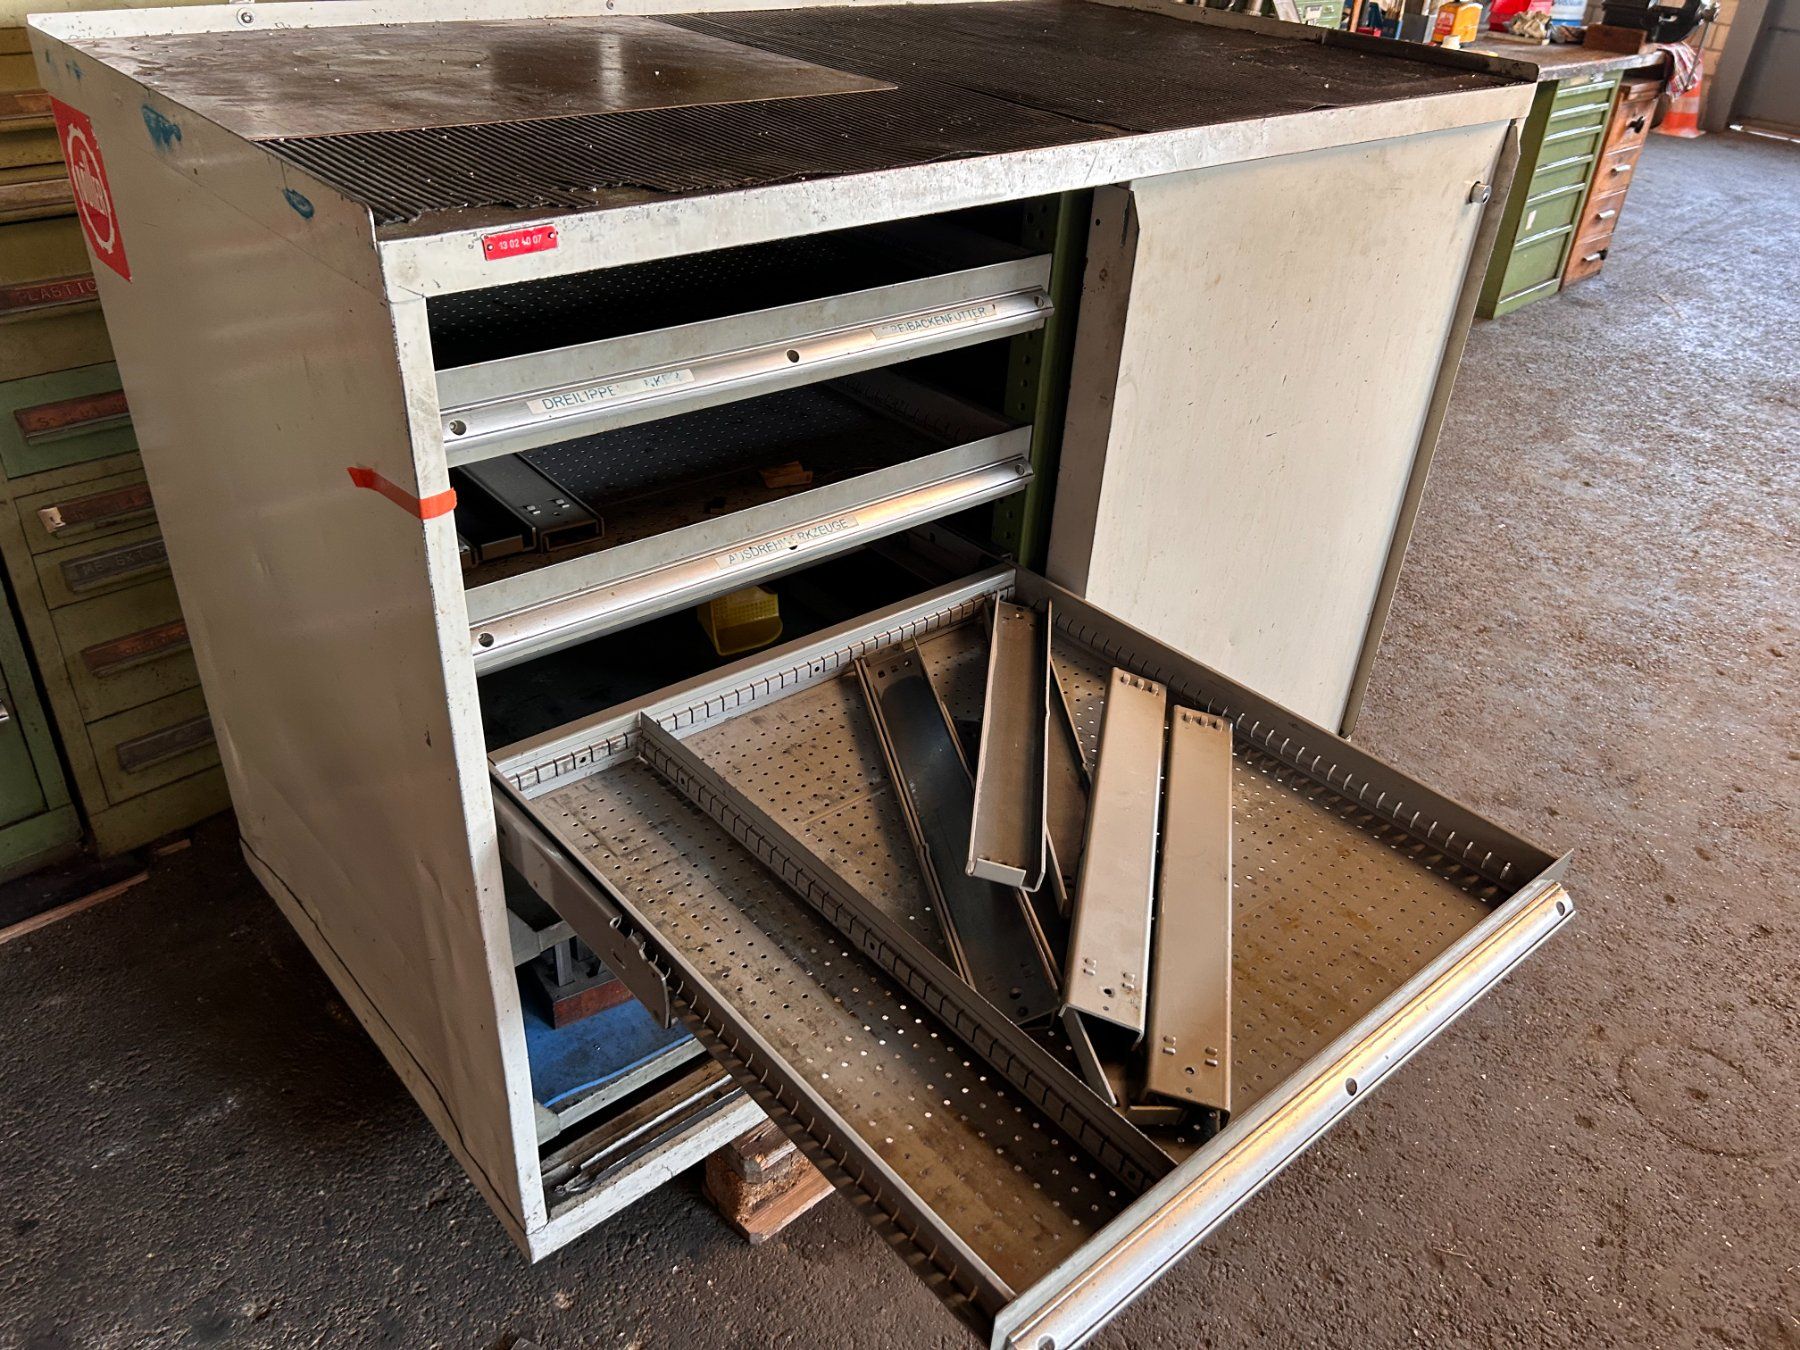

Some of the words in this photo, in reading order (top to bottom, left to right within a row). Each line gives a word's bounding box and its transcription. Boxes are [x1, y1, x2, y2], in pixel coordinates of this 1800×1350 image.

[509, 238, 520, 248] 02
[521, 236, 532, 246] 40
[532, 234, 543, 244] 07
